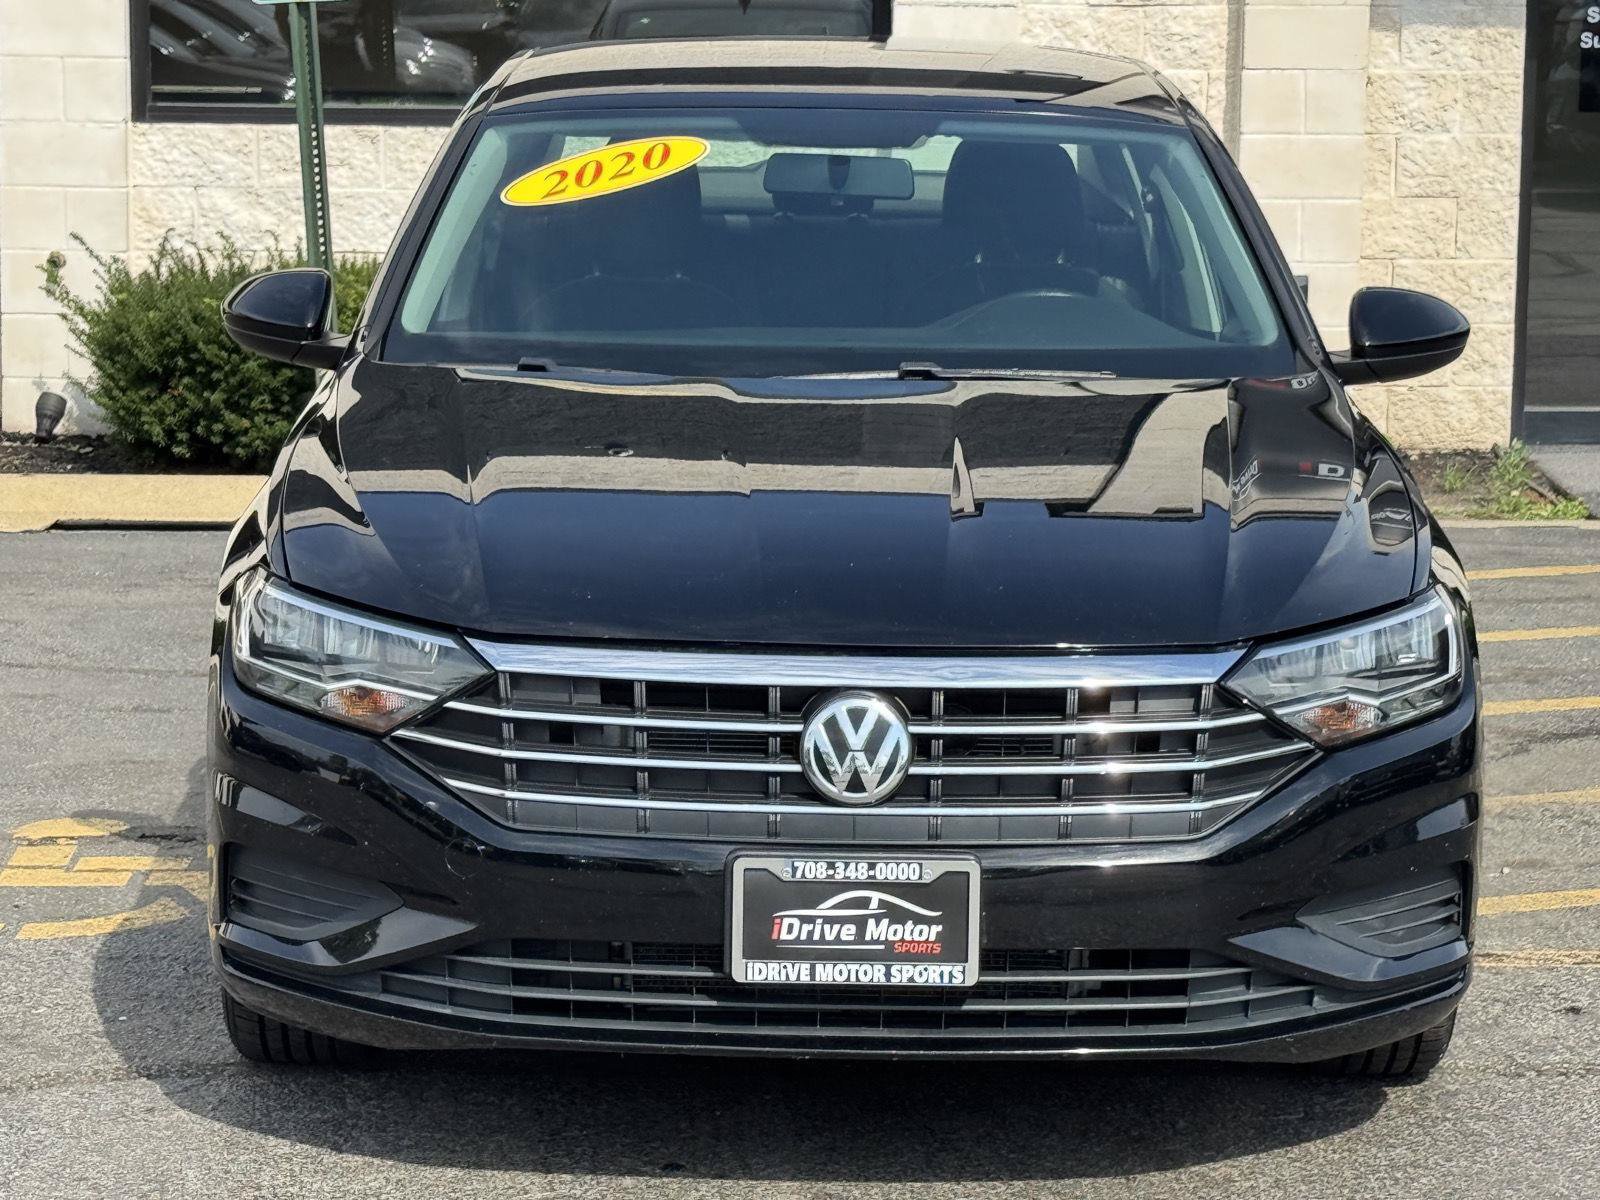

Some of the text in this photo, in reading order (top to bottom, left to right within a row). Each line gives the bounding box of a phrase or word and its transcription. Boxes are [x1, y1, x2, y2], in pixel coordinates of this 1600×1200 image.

[541, 142, 671, 199] 2020
[793, 861, 920, 880] 708-348-0000
[771, 917, 943, 942] iDrive Motor
[893, 942, 942, 954] SPORTS
[815, 963, 887, 982] MOTOR
[890, 965, 964, 984] SPORTS
